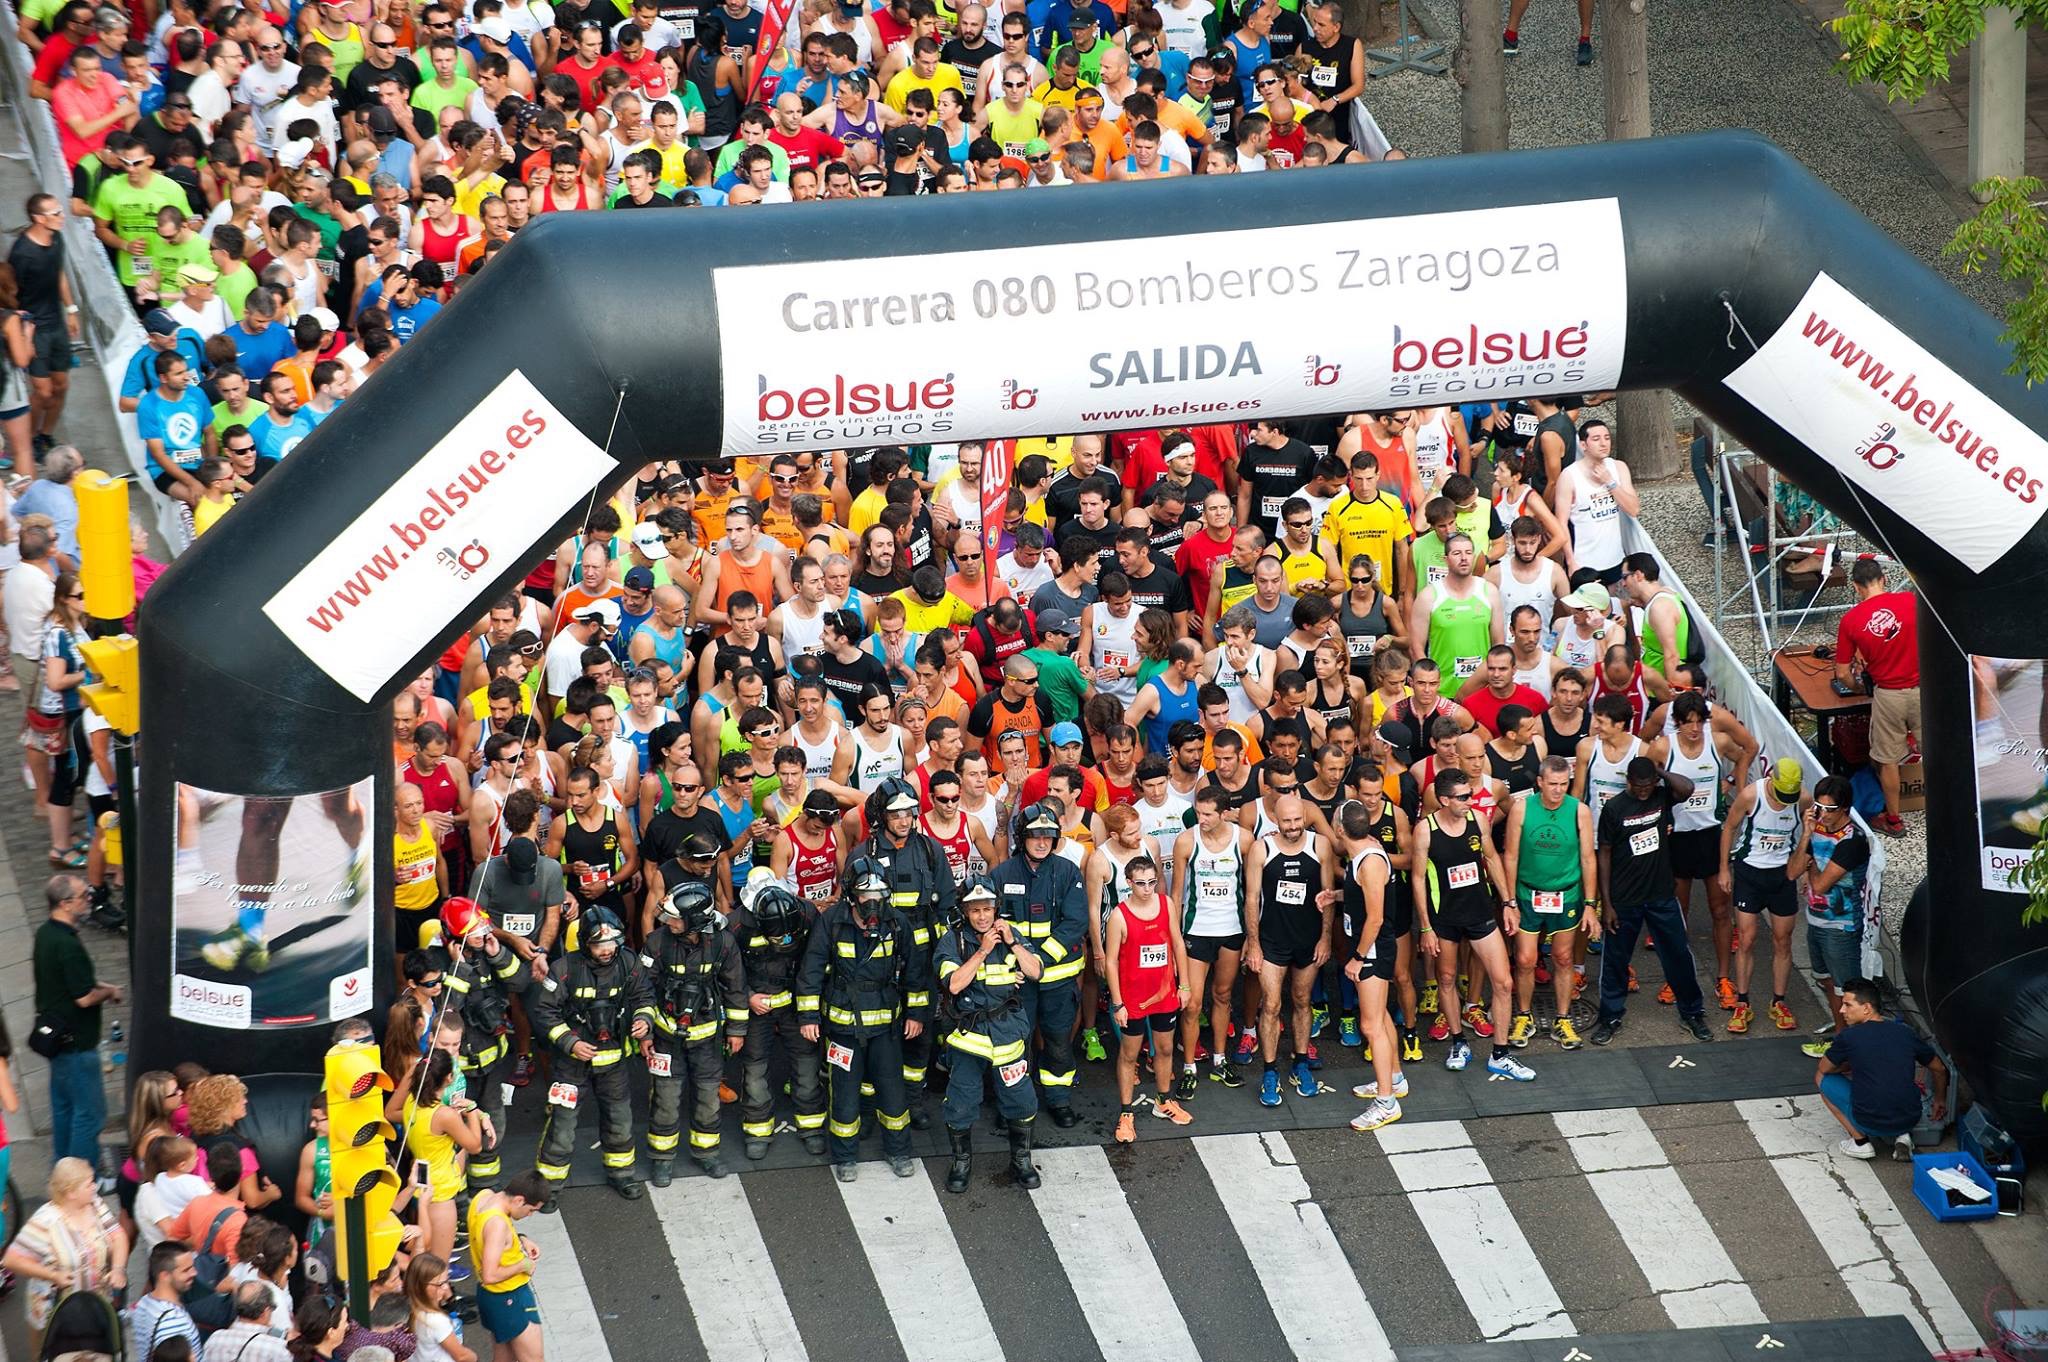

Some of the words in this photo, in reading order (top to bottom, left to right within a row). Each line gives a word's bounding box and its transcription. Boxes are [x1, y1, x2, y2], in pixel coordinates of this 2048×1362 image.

[1315, 73, 1332, 82] 487
[782, 292, 955, 332] Carrera
[972, 274, 1057, 319] 080
[1075, 260, 1319, 312] Bomberos
[1335, 242, 1560, 292] Zaragoza
[1089, 341, 1263, 389] SALIDA
[1391, 370, 1460, 384] agencia
[1471, 362, 1557, 376] vinculada
[1566, 359, 1587, 368] de
[1081, 398, 1262, 422] www.belsue.es
[1801, 311, 2044, 504] www.belsue.es
[757, 418, 828, 432] agencia
[838, 412, 925, 426] vinculada
[933, 409, 954, 418] de
[1517, 421, 1539, 432] 1717
[983, 440, 1006, 495] 40
[306, 408, 547, 633] www.belsue.es
[1352, 644, 1371, 652] 726
[1109, 656, 1122, 667] 69
[1460, 664, 1477, 673] 286
[1005, 714, 1033, 729] ARANDA
[1634, 835, 1659, 851] 2333
[226, 878, 288, 902] querido
[293, 880, 309, 893] es
[811, 888, 829, 900] 269
[1203, 887, 1228, 897] 1430
[1282, 888, 1301, 899] 454
[506, 922, 532, 931] 1210
